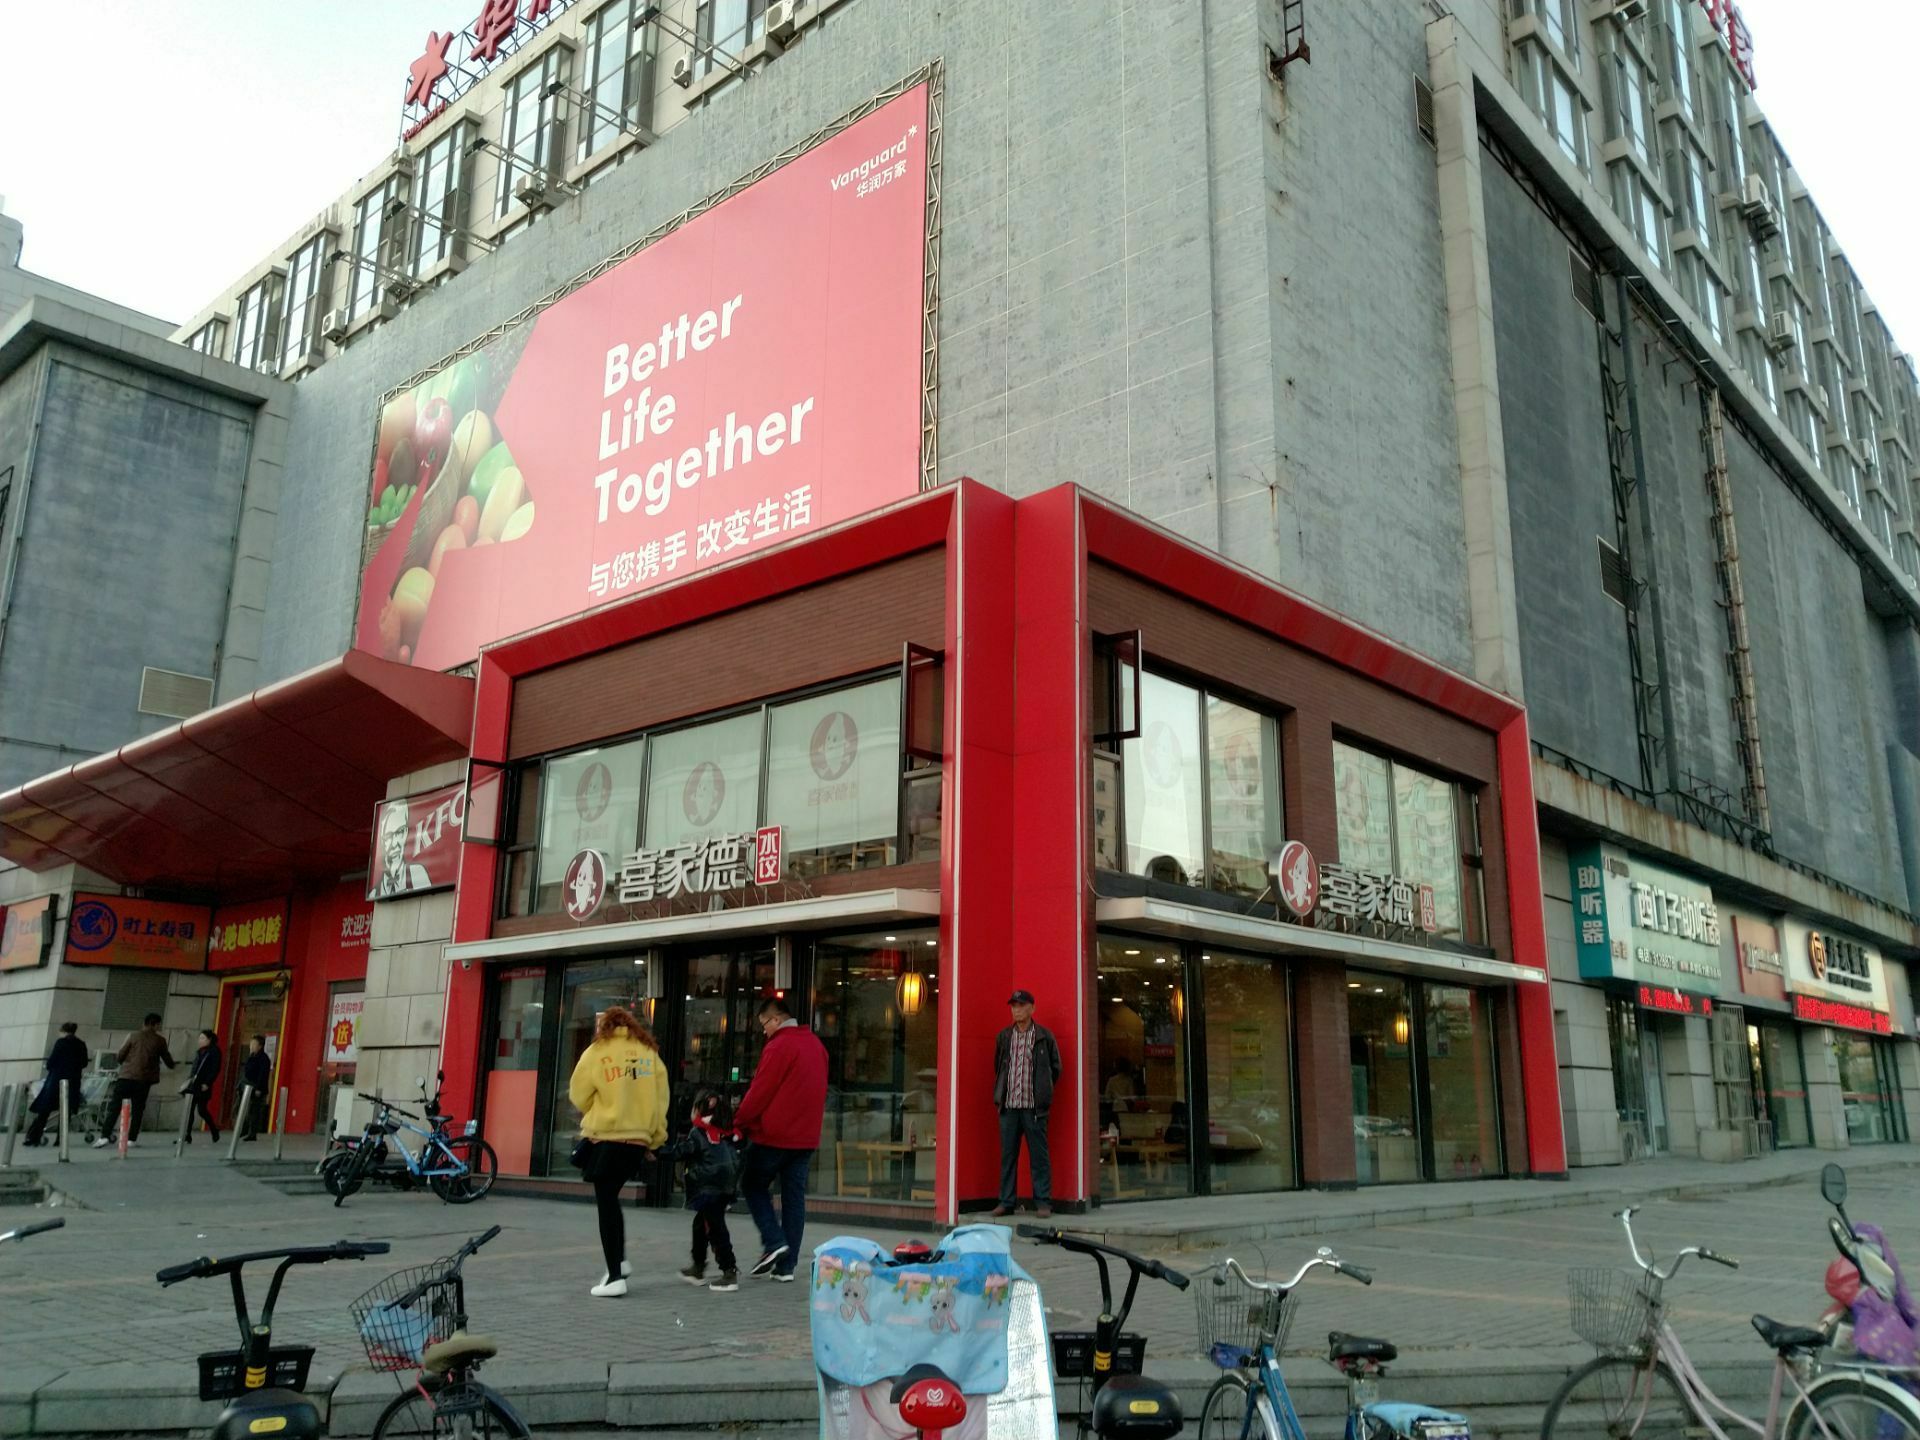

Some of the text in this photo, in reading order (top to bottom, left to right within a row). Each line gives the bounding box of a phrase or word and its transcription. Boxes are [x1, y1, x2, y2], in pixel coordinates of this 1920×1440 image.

[856, 159, 907, 198] 华润万家
[604, 294, 743, 399] Better
[599, 386, 676, 461] Life
[594, 396, 814, 524] Together
[588, 484, 812, 597] 与您携手 改变生活
[412, 788, 467, 858] KFC
[759, 832, 779, 879] 水饺
[619, 832, 742, 903] 喜家德
[1322, 862, 1415, 931] 喜家德
[1577, 865, 1605, 945] 助听器
[1632, 881, 1721, 946] 西门子助听器
